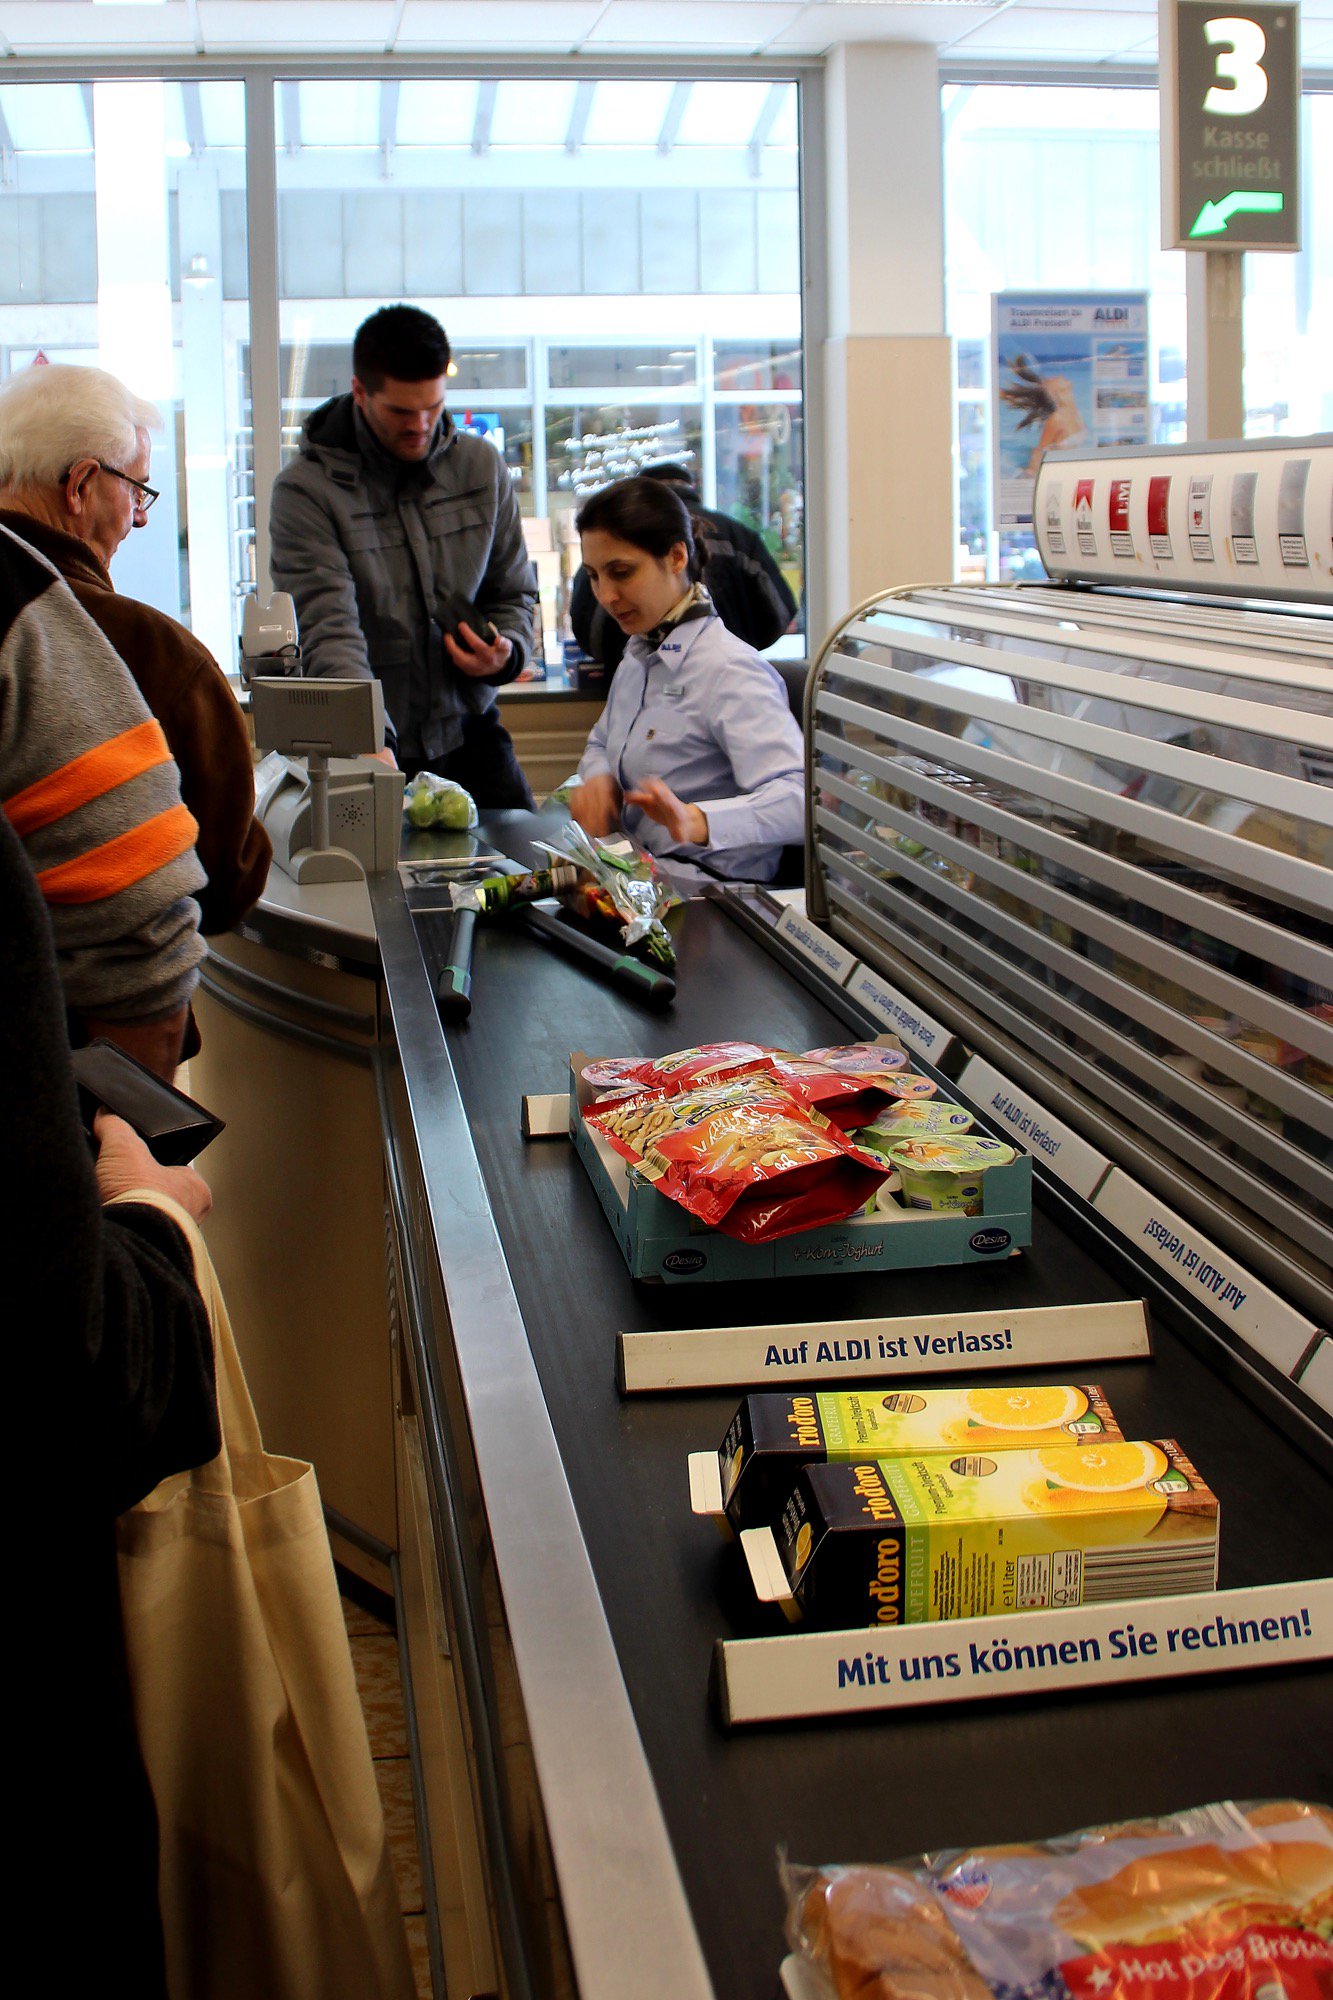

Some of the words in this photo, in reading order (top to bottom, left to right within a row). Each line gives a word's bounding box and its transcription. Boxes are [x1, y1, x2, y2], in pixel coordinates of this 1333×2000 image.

[1203, 16, 1268, 116] 3
[1203, 125, 1270, 149] Kasse
[1191, 155, 1281, 179] schließt
[1094, 307, 1128, 320] ALDI
[990, 1092, 1009, 1109] Auf
[1004, 1103, 1024, 1122] ALDI
[1017, 1112, 1030, 1132] ist
[1027, 1121, 1061, 1157] Verlass!
[973, 1233, 1008, 1248] Desira
[1143, 1217, 1186, 1260] Verlass!
[667, 1255, 702, 1268] Desira
[1181, 1249, 1200, 1276] ist
[1197, 1262, 1225, 1292] ALDI
[1220, 1278, 1247, 1311] Auf
[764, 1341, 809, 1366] Auf
[815, 1339, 871, 1363] ALDI
[877, 1334, 908, 1359] ist
[913, 1328, 1013, 1356] Verlass!
[822, 1396, 843, 1445] GRAPEFRUIT
[910, 1535, 924, 1623] APEFRUIT
[838, 1653, 890, 1688] Mit
[899, 1652, 961, 1681] uns
[969, 1638, 1101, 1674] können
[1108, 1624, 1158, 1659] Sie
[1167, 1608, 1312, 1653] rechnen!
[1118, 1957, 1179, 1983] Hot
[1180, 1946, 1244, 1981] Dog
